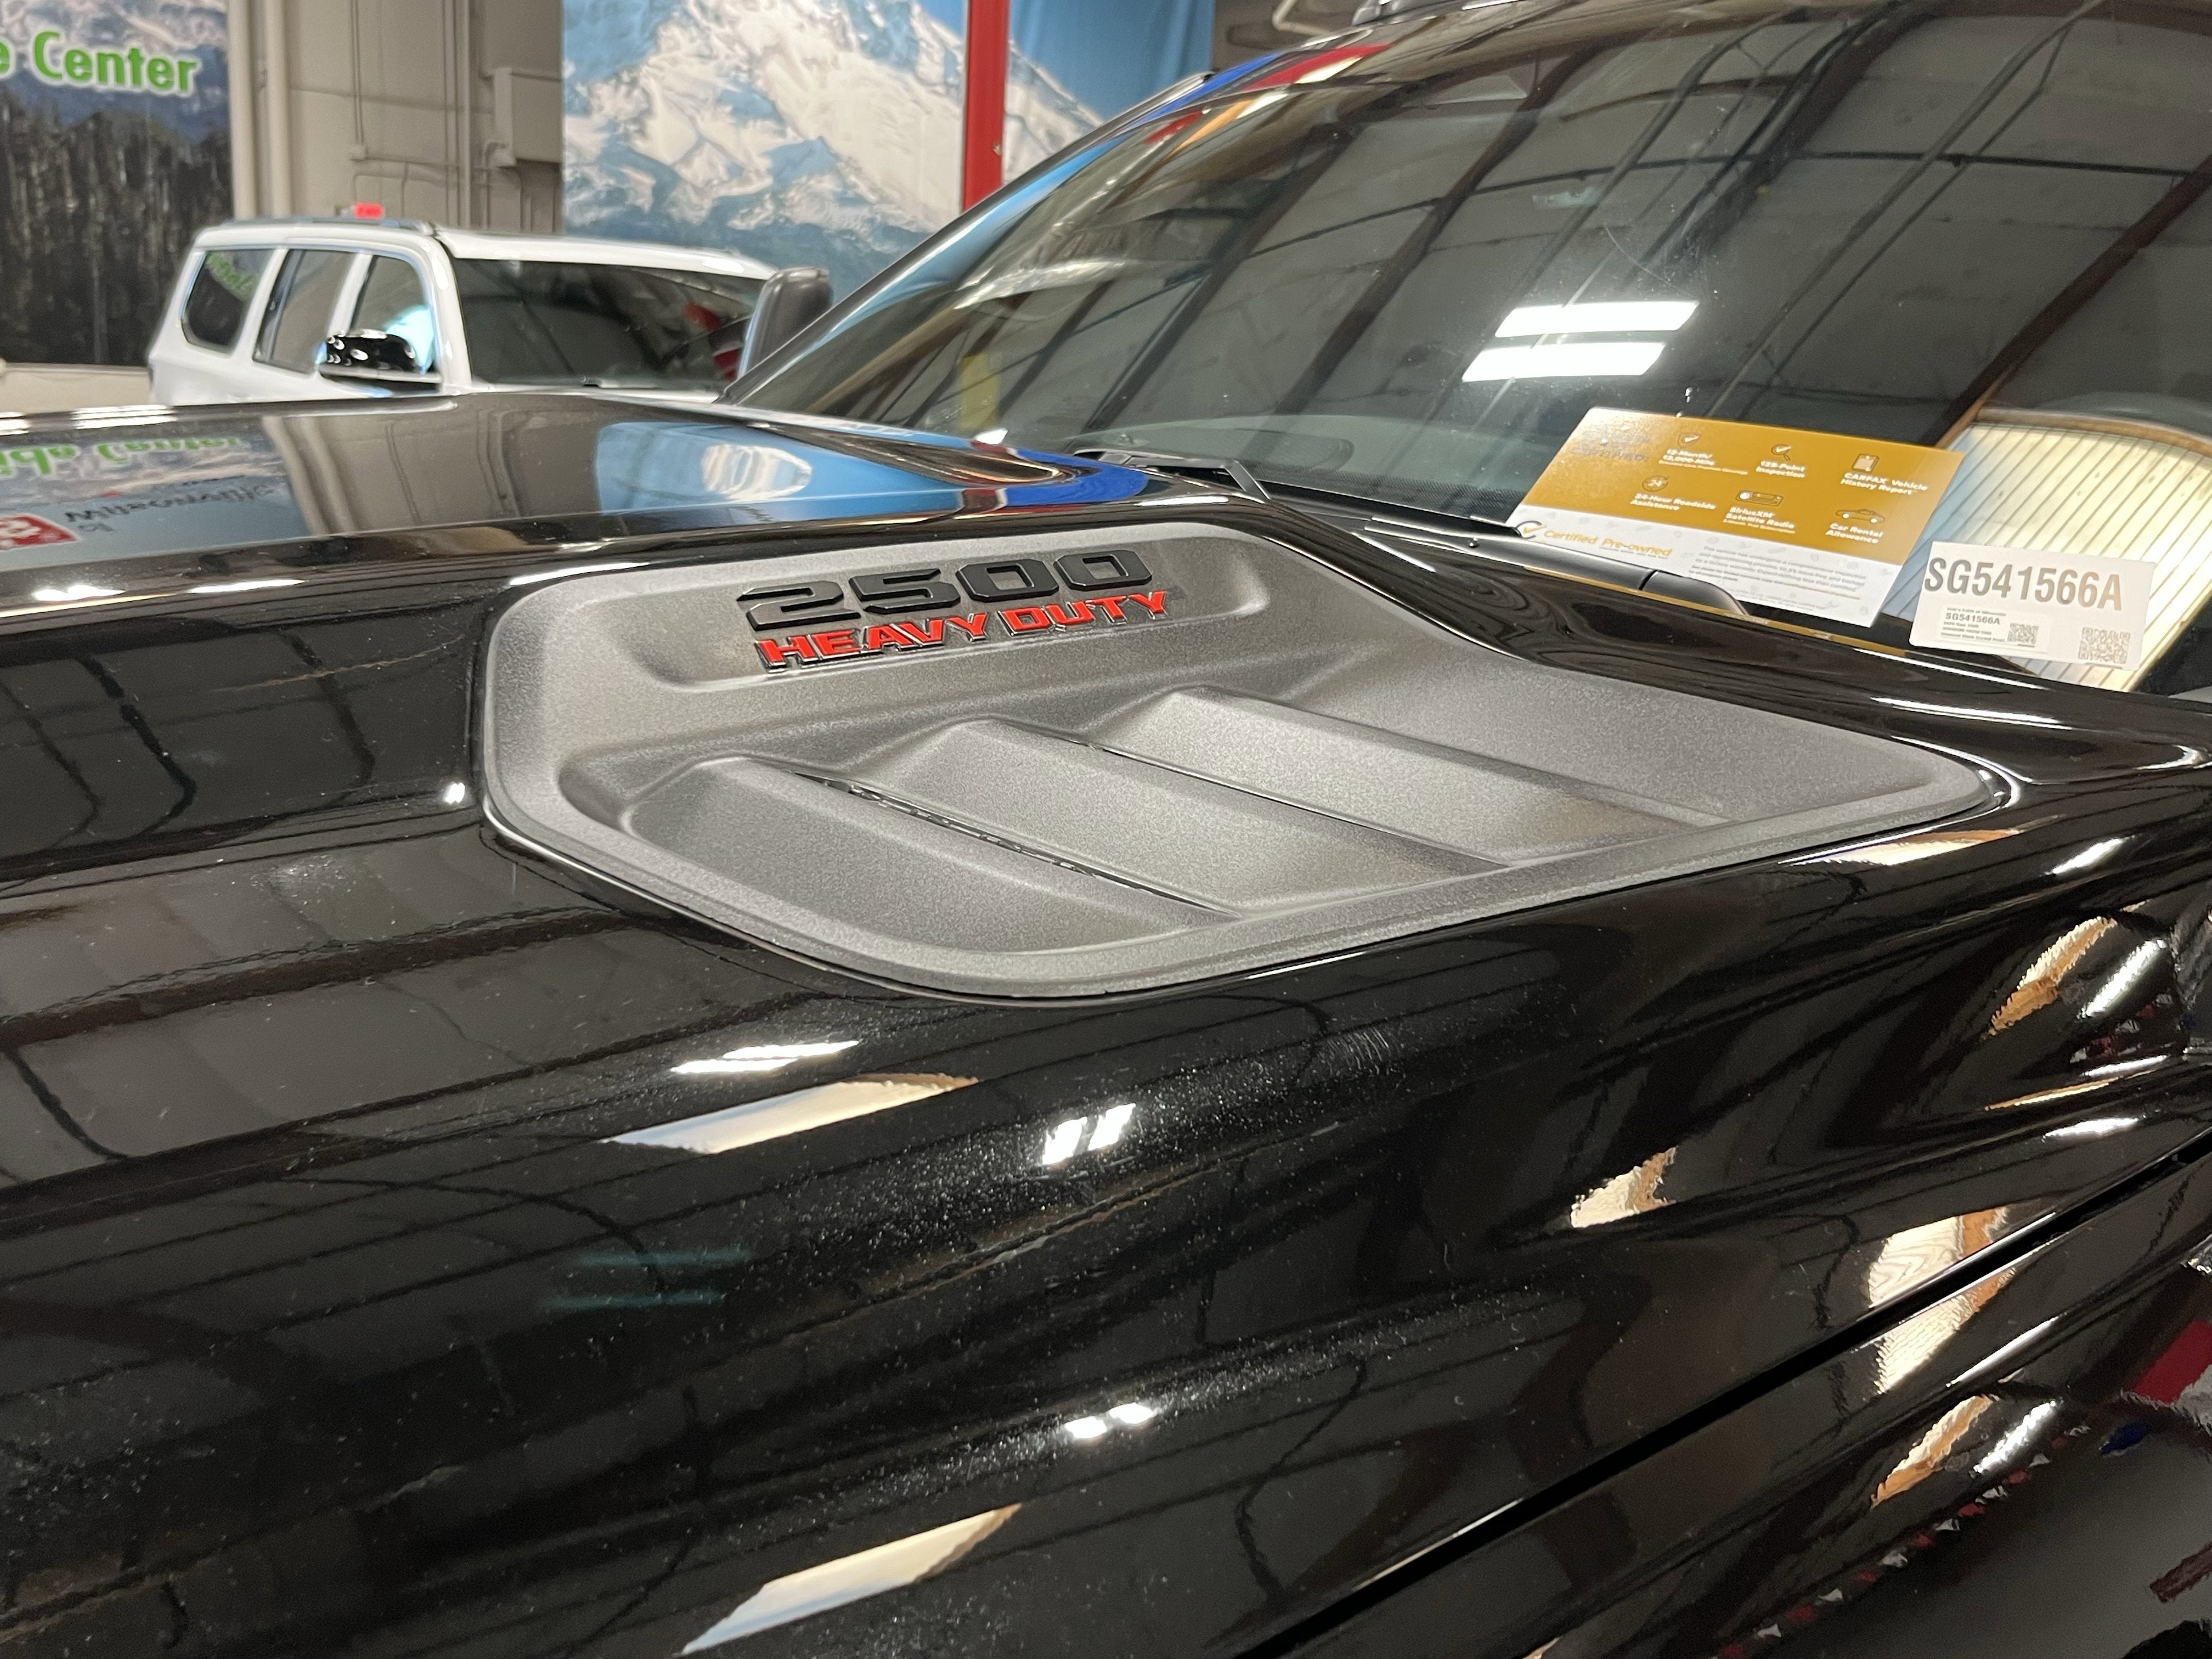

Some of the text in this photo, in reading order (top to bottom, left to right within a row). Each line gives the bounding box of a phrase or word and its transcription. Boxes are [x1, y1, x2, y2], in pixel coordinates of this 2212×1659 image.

[31, 29, 198, 94] Center
[1756, 466, 1805, 478] Inspection
[1840, 478, 1912, 495] History Report
[1892, 479, 1928, 491] Vehicle
[1630, 499, 1680, 511] Assistance
[1634, 493, 1716, 510] 24-Hour Roadside
[1725, 513, 1765, 524] Satellite
[1767, 519, 1795, 529] Radio
[1825, 529, 1878, 544] Allowance
[1830, 522, 1883, 538] Car Rental
[1543, 530, 1598, 544] Certified
[1601, 537, 1672, 557] Pre-owned
[736, 550, 1153, 631] 2500
[1923, 557, 2122, 612] SG541566A
[1945, 612, 2000, 625] SG541566A
[754, 590, 1166, 673] HEAVY DUTY
